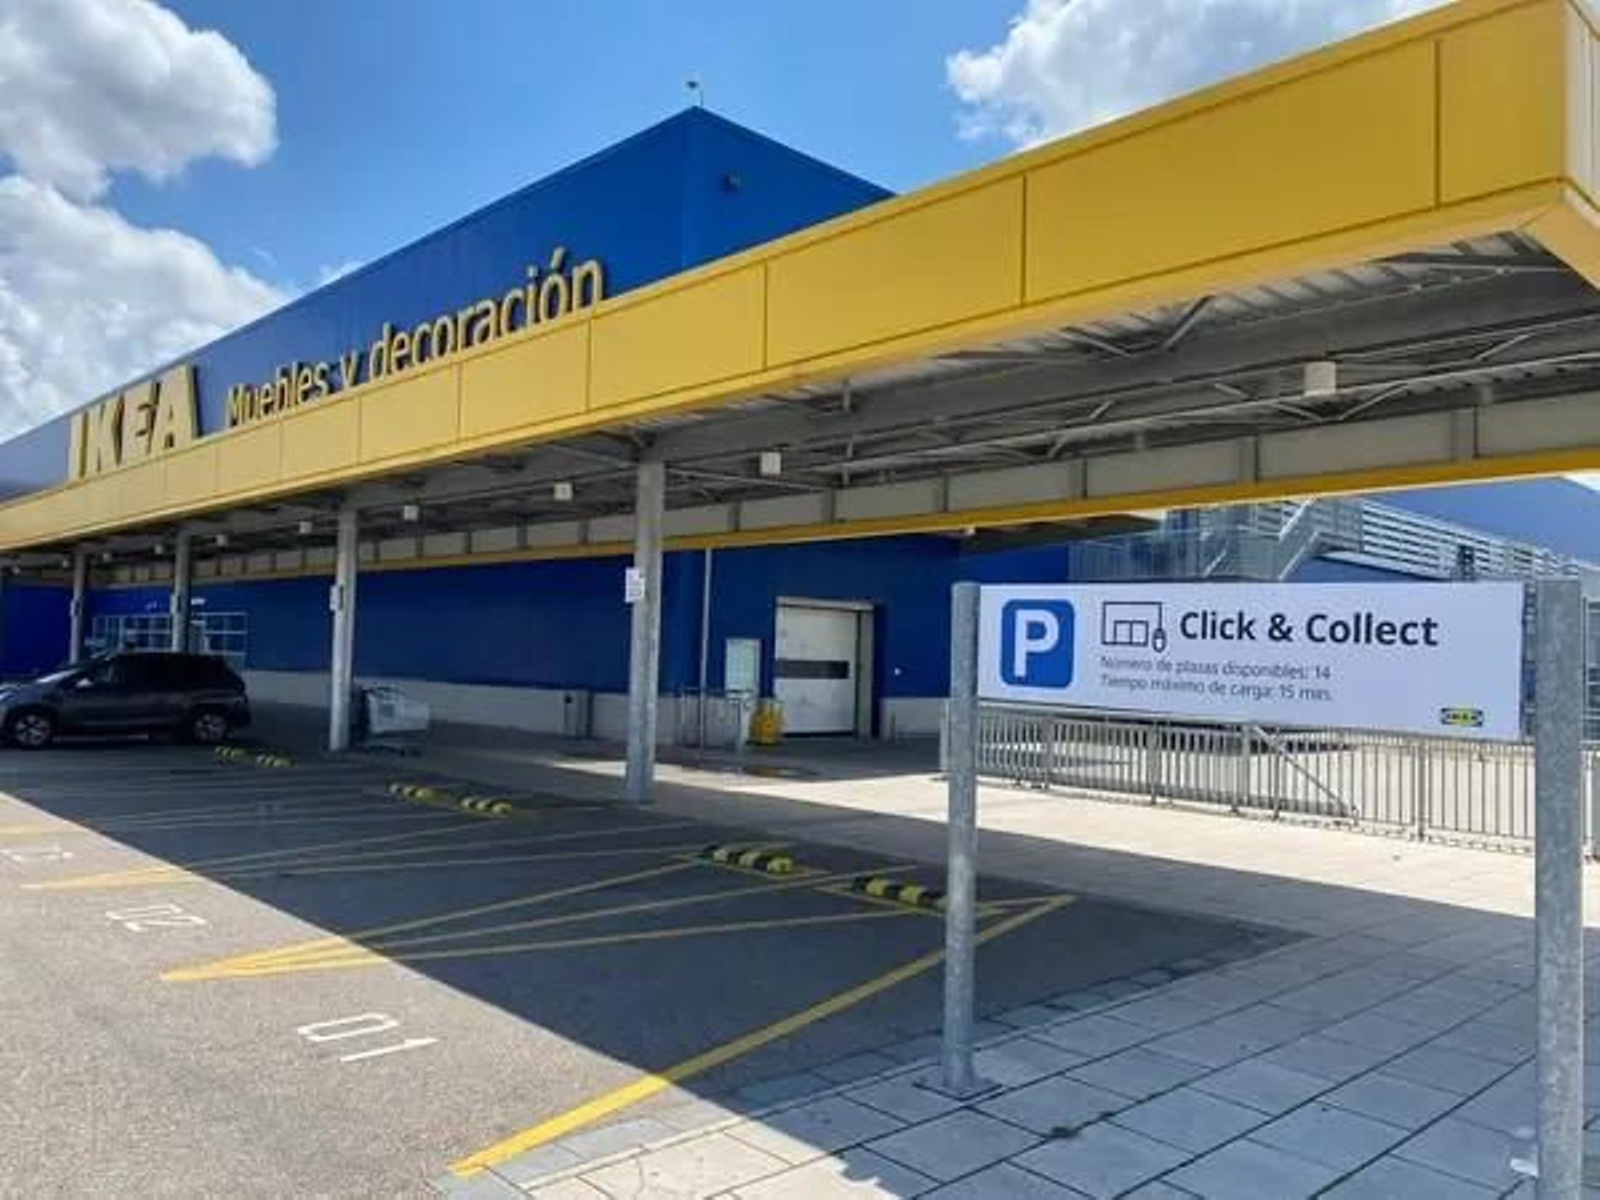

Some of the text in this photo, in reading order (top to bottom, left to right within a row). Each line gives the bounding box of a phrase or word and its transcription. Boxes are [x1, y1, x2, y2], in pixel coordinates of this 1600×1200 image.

[226, 360, 331, 428] Muebles
[370, 246, 604, 381] decoración
[68, 363, 197, 480] IKEA
[1014, 609, 1060, 678] P
[1180, 610, 1439, 646] Click & Collect
[1156, 657, 1173, 672] de
[1315, 665, 1331, 680] 14
[1208, 680, 1226, 696] de
[1279, 684, 1295, 699] 15
